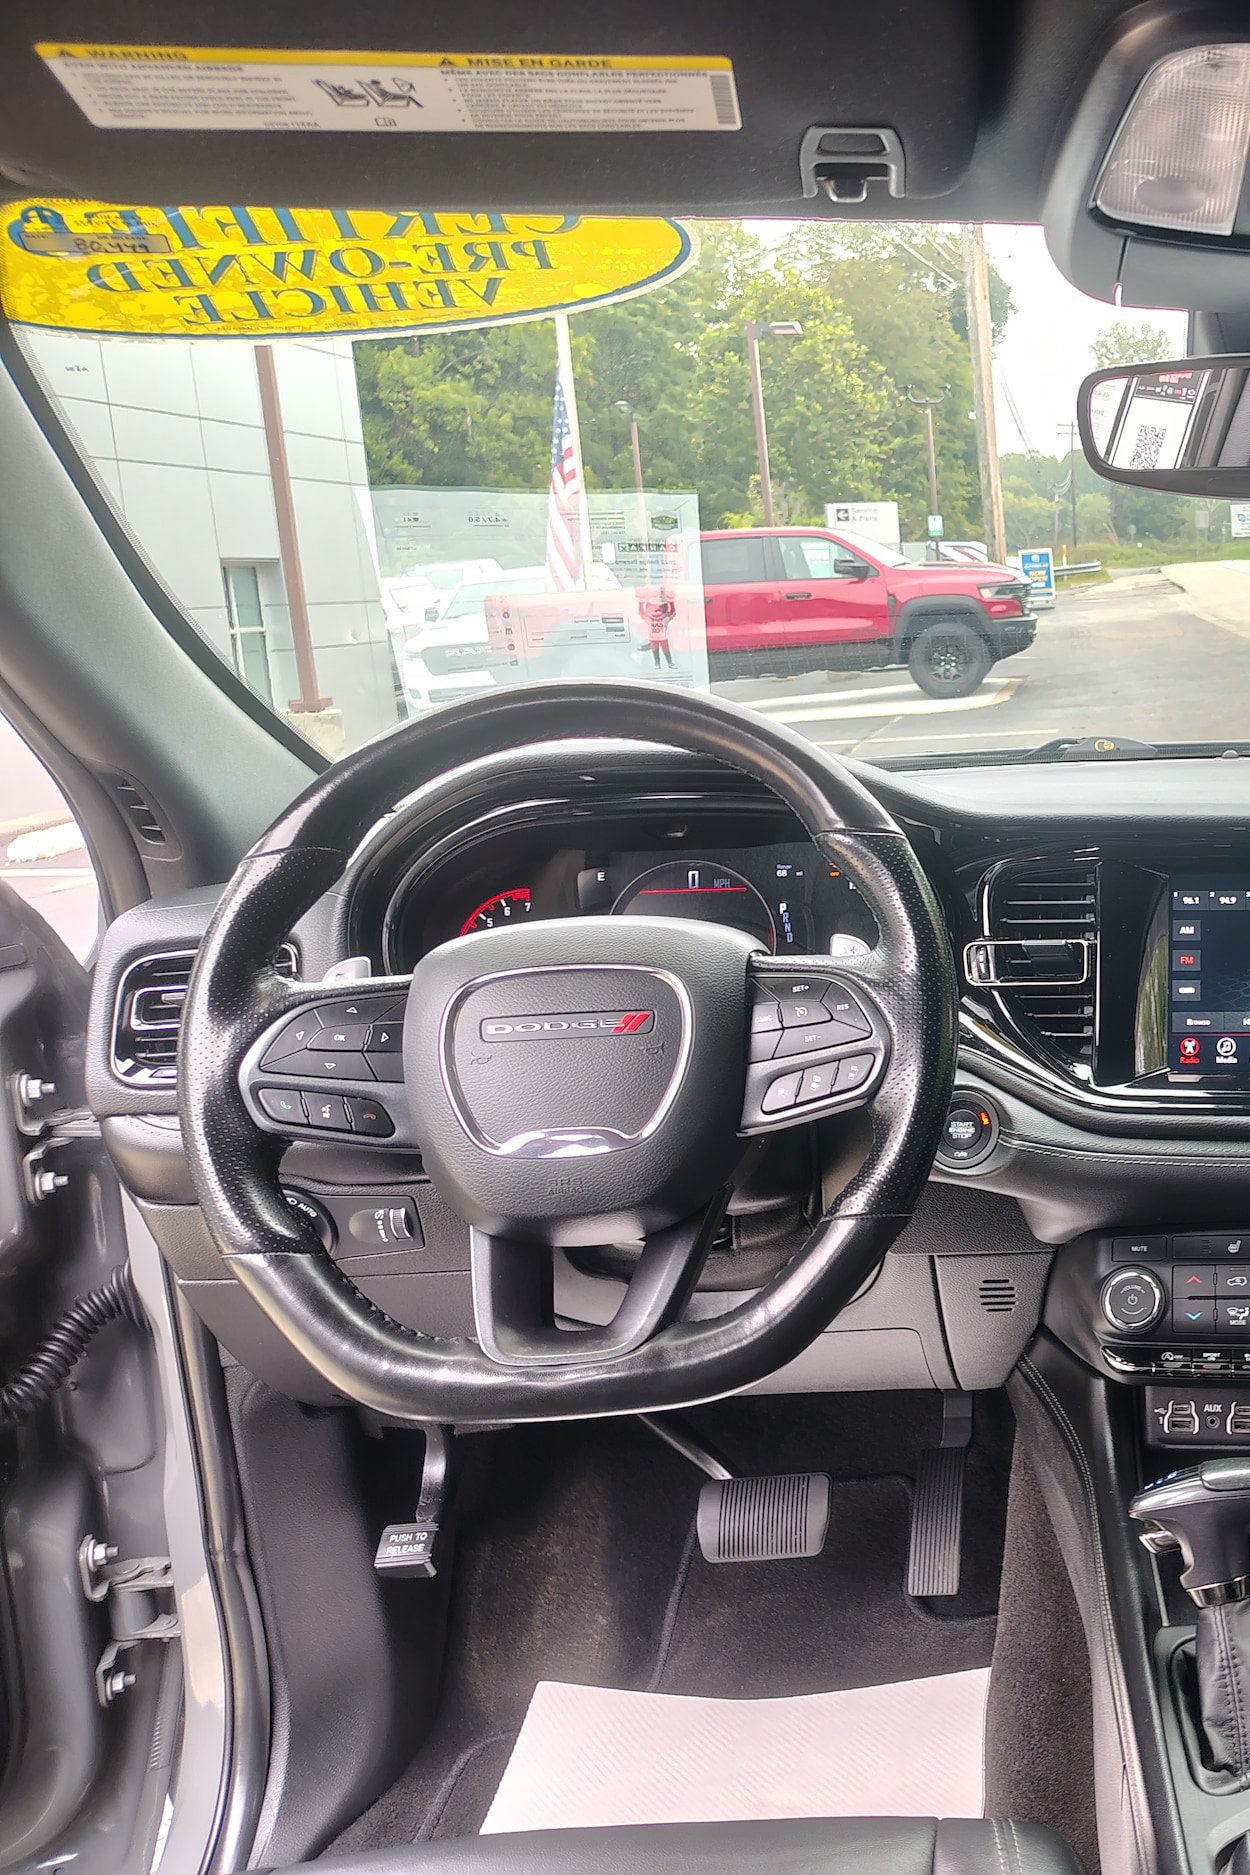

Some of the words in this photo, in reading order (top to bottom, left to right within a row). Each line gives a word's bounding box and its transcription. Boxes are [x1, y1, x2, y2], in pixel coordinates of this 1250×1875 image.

[87, 48, 190, 62] WARNING
[467, 57, 513, 67] MISE
[519, 58, 543, 68] EN
[550, 58, 612, 69] GARDE
[597, 872, 606, 881] E
[713, 878, 731, 889] MPH
[504, 907, 511, 917] 6
[524, 902, 531, 912] 7
[779, 903, 787, 914] P
[782, 912, 789, 922] R
[486, 917, 494, 928] 5
[784, 922, 791, 932] N
[1179, 926, 1195, 934] AM
[787, 932, 794, 942] D
[1179, 956, 1194, 965] FM
[836, 1003, 850, 1011] RES
[486, 1017, 623, 1035] DODGE
[1186, 1018, 1211, 1026] Browse
[333, 1034, 346, 1042] OK
[1179, 1056, 1200, 1064] Radio
[1215, 1056, 1238, 1064] Media
[298, 1203, 317, 1218] AUTO
[1203, 1403, 1222, 1413] AUX
[1158, 1416, 1163, 1426] 1
[388, 1532, 413, 1543] PUSH
[415, 1531, 428, 1541] TO
[386, 1543, 426, 1555] RELEASE
